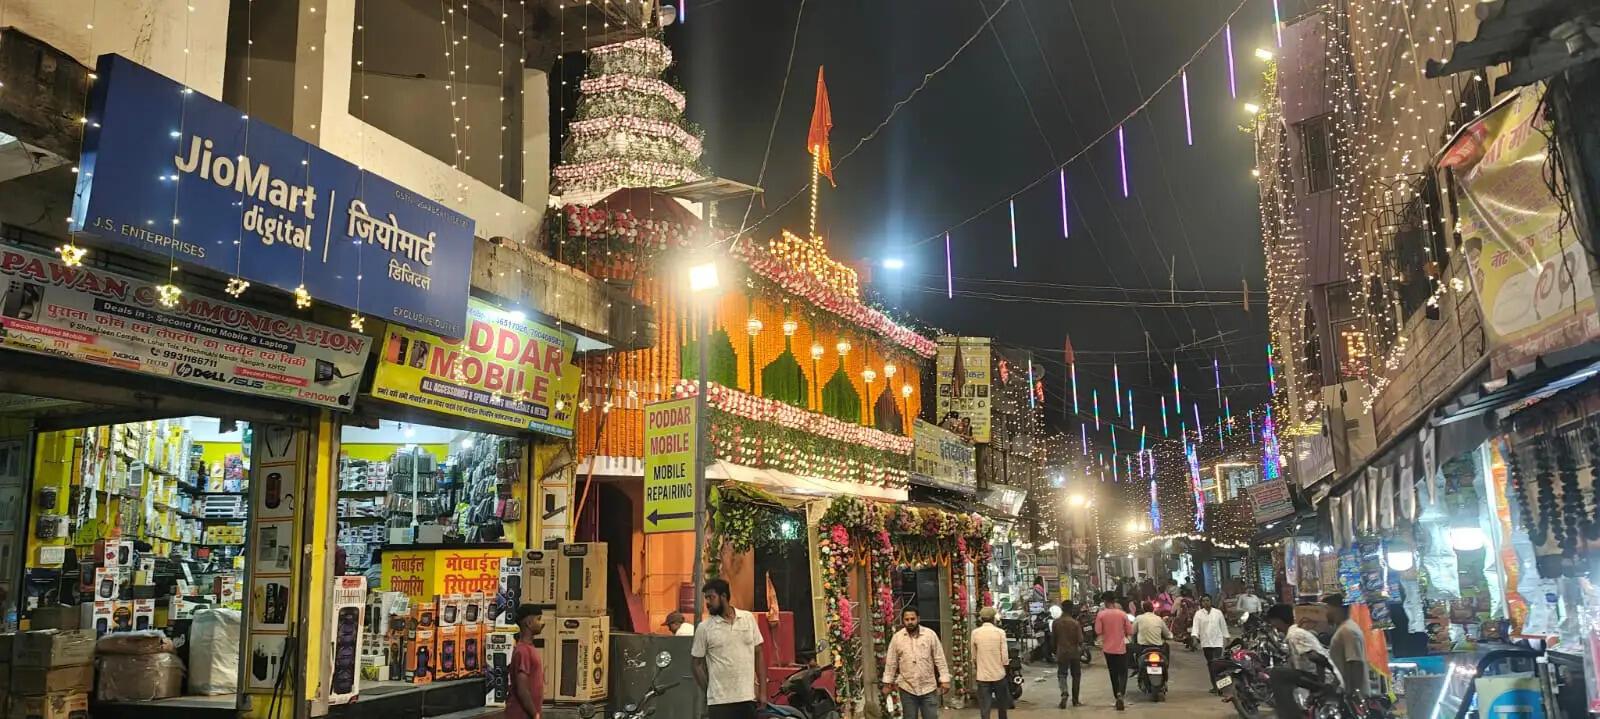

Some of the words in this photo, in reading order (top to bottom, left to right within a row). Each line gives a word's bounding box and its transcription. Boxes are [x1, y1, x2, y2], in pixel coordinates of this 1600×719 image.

[174, 136, 317, 219] JioMart
[93, 217, 116, 232] J.S.
[121, 224, 205, 258] ENTERPRISES
[243, 205, 312, 251] digital
[348, 200, 436, 266] जियोमार्ट
[388, 259, 431, 290] डिजिटल
[1, 252, 128, 299] PAWAN
[134, 286, 364, 355] CMMUNICATION
[48, 304, 88, 320] पुराना
[131, 322, 152, 334] एवं
[103, 302, 132, 316] Deals
[155, 315, 191, 328] Second
[193, 323, 217, 334] Hand
[219, 328, 248, 342] Mobile
[259, 338, 289, 351] Laptop
[393, 306, 432, 326] EXCLUSIVE
[9, 333, 42, 343] vivo
[441, 319, 564, 378] DDAR
[112, 351, 140, 361] NOKIA
[163, 351, 217, 367] 9931166711
[193, 367, 226, 382] DELL
[227, 376, 264, 389] ASUS
[430, 346, 549, 403] MOBILE
[264, 382, 298, 393] acer
[297, 387, 337, 402] Lenovo
[422, 380, 433, 391] ALL
[649, 406, 691, 429] PODDAR
[650, 432, 689, 456] MOBILE
[653, 463, 686, 480] MOBILE
[647, 483, 692, 502] REPAIRING
[391, 554, 425, 573] मोबाईल
